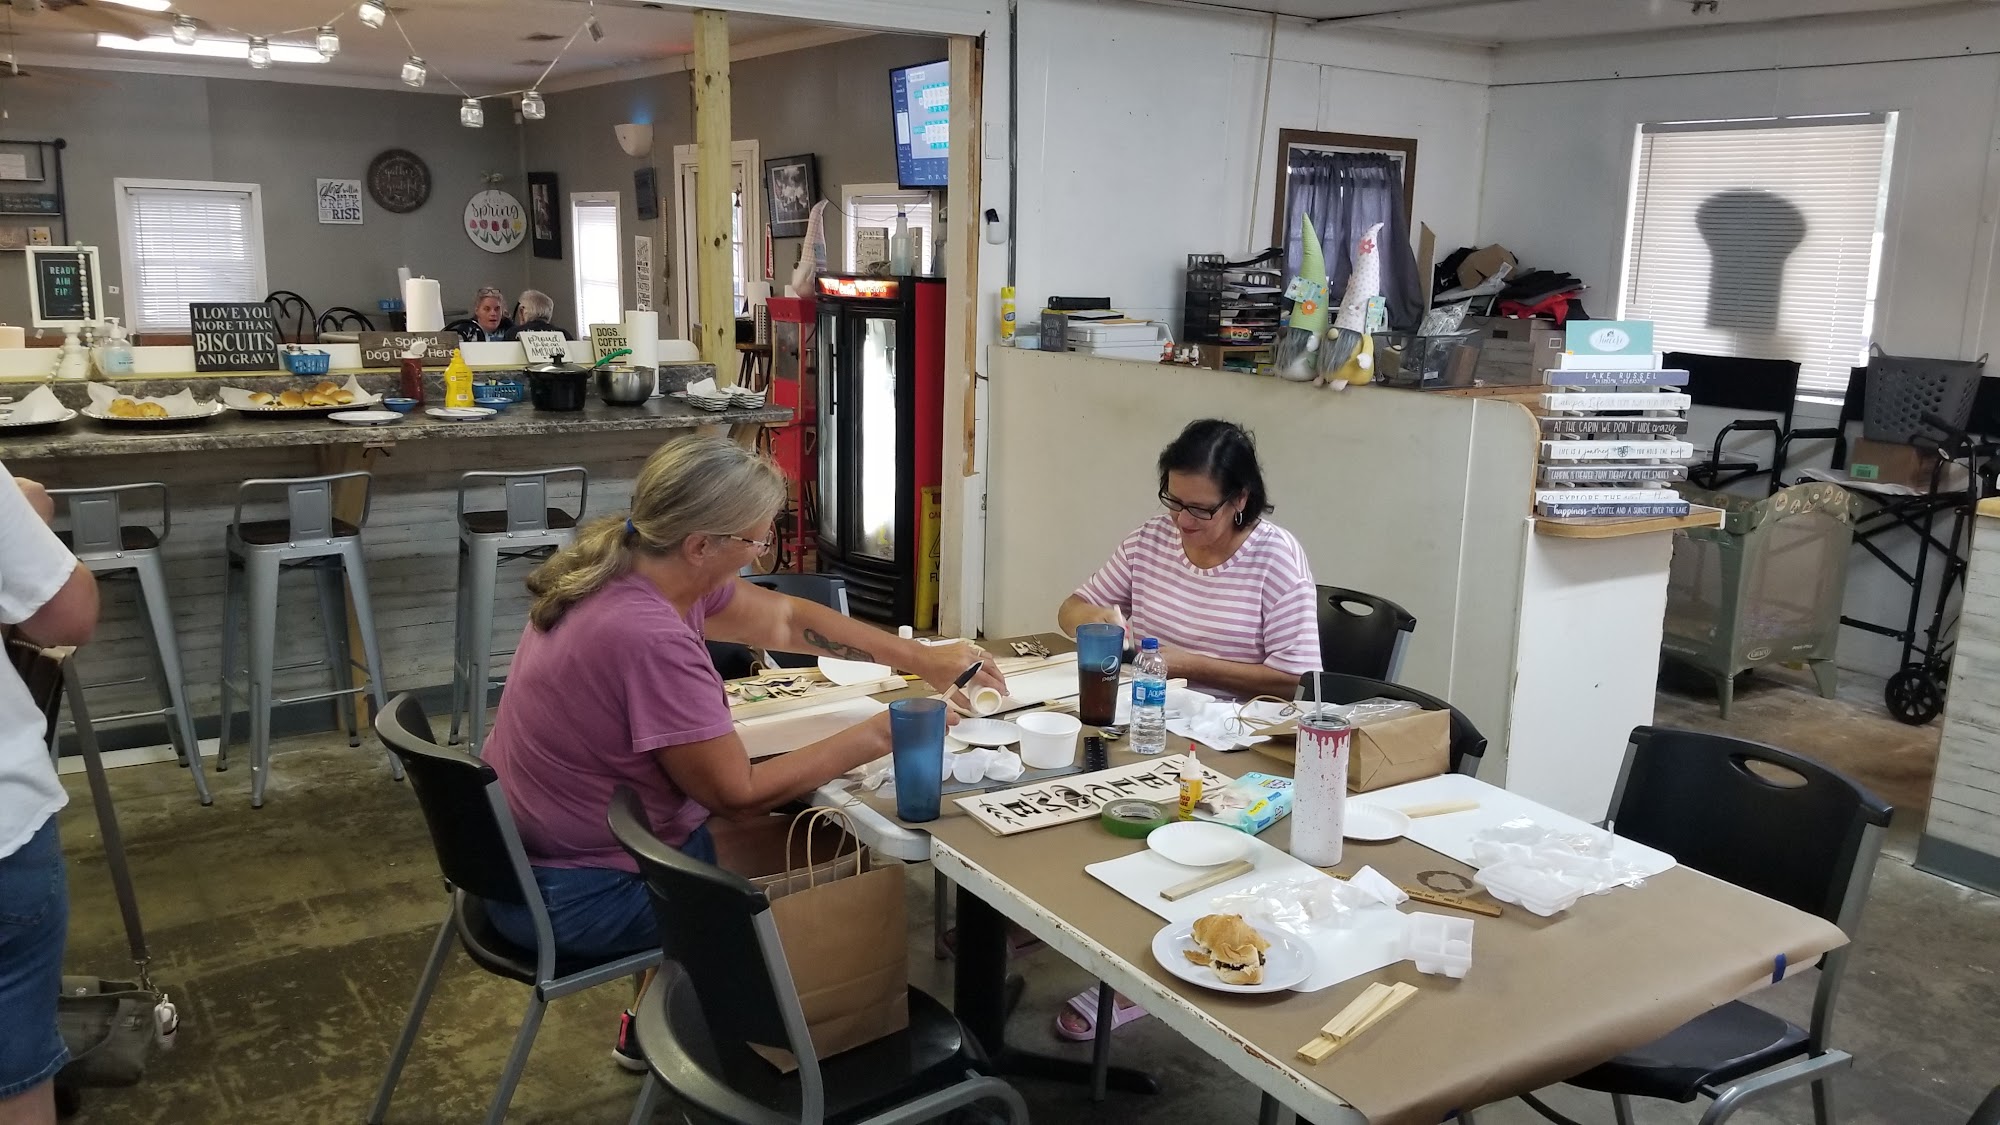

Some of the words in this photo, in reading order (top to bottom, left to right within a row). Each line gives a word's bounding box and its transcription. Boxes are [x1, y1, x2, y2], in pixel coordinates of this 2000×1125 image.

[320, 198, 360, 209] CREEK
[332, 208, 360, 220] RISE
[471, 203, 519, 220] spring
[55, 277, 71, 286] AIM
[193, 307, 199, 319] I
[202, 307, 240, 319] LOVE
[243, 306, 272, 319] YOU
[195, 321, 234, 331] MORE
[236, 320, 273, 330] THAN
[195, 332, 275, 352] BISCUITS
[382, 337, 391, 347] A
[528, 335, 561, 345] proud
[365, 350, 390, 361] Dog
[428, 348, 455, 358] Here
[531, 347, 566, 357] AMERICAN
[198, 354, 227, 365] AND
[229, 353, 276, 364] GRAVY
[1585, 372, 1611, 380] LAKE
[1618, 372, 1657, 380] RUSSEL
[1553, 422, 1562, 432] AT
[1565, 422, 1575, 432] THE
[1579, 421, 1598, 432] CABIN
[1602, 422, 1611, 432] WE
[1637, 422, 1650, 432] HIDE
[1651, 424, 1677, 435] crazy
[1551, 470, 1570, 480] CAMPING
[1595, 470, 1607, 480] THAN
[1553, 503, 1588, 517] happiness
[1597, 506, 1615, 515] COFFEE
[1616, 506, 1627, 515] AND
[1627, 506, 1632, 515] A
[1632, 506, 1651, 515] SUNSET
[1652, 506, 1664, 515] OVER
[1666, 506, 1675, 515] THE
[1676, 506, 1688, 515] LAKE
[1147, 690, 1166, 698] AQUAF
